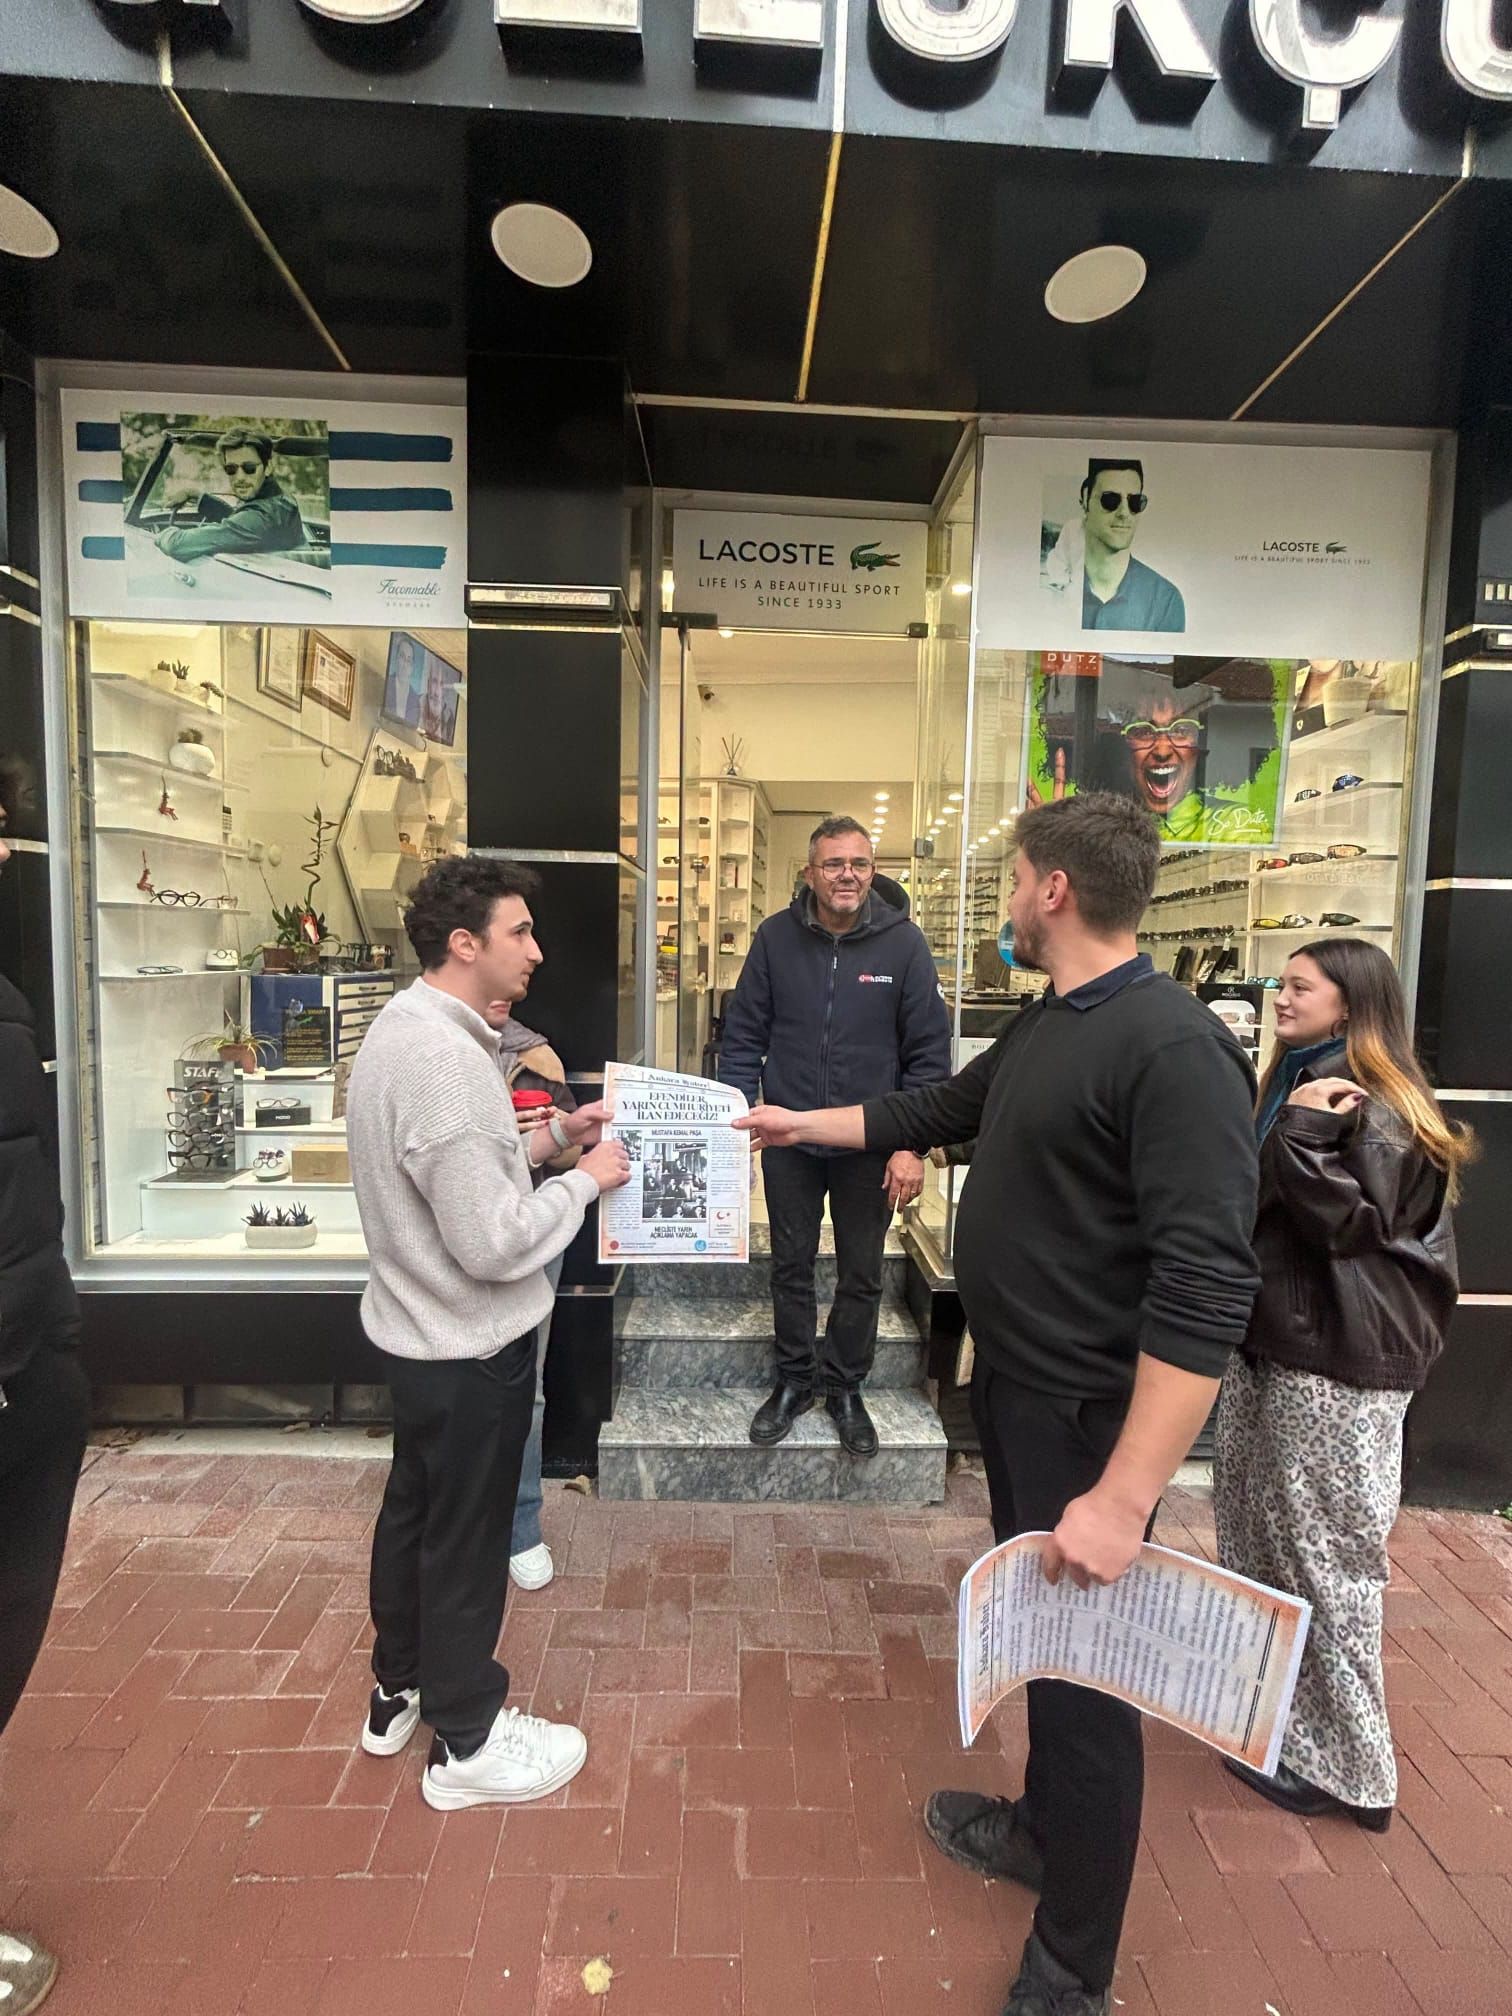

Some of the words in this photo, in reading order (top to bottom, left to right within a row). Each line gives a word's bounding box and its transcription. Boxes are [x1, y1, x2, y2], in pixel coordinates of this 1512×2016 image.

[700, 539, 835, 566] LACOSTE
[1263, 541, 1320, 552] LACOSTE
[699, 578, 727, 588] LIFE
[735, 579, 747, 589] IS
[754, 580, 762, 590] A
[770, 580, 848, 594] BEAUTIFUL
[855, 584, 900, 596] SPORT
[757, 596, 799, 608] SINCE
[808, 598, 842, 610] 1933
[1047, 653, 1097, 664] DUTZ
